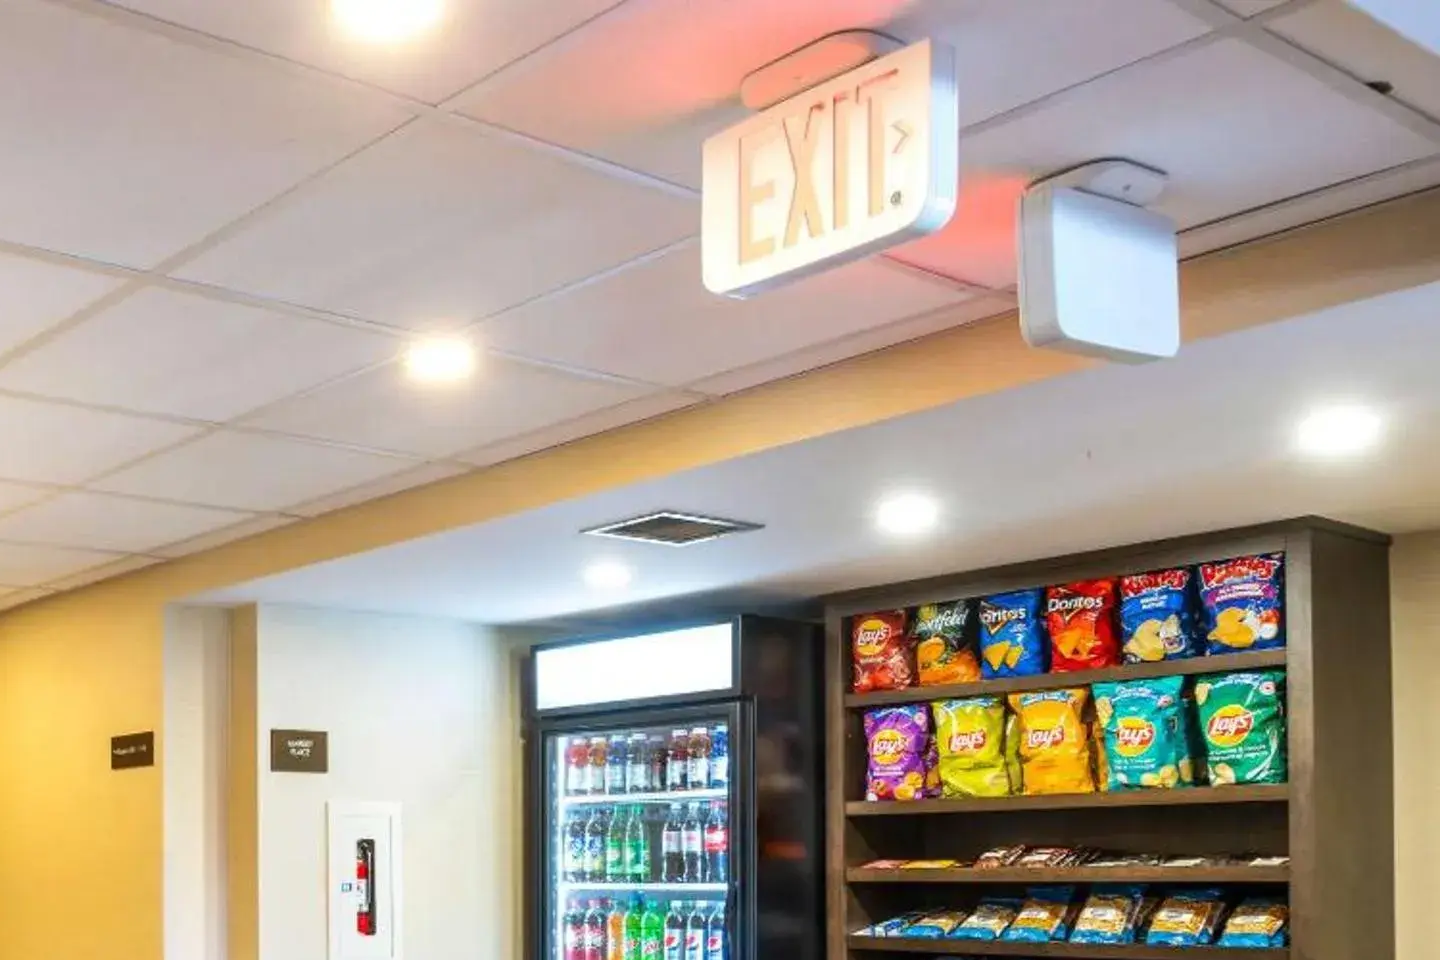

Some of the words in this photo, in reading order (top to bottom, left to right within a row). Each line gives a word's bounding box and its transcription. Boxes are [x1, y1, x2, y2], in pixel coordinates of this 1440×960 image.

[738, 69, 898, 266] EXIT
[980, 607, 1027, 623] oritos
[1048, 596, 1103, 612] Doritos
[857, 627, 889, 646] Lay's
[1208, 712, 1250, 737] Lay's
[950, 730, 984, 752] Lay's
[1027, 726, 1063, 749] Lay's
